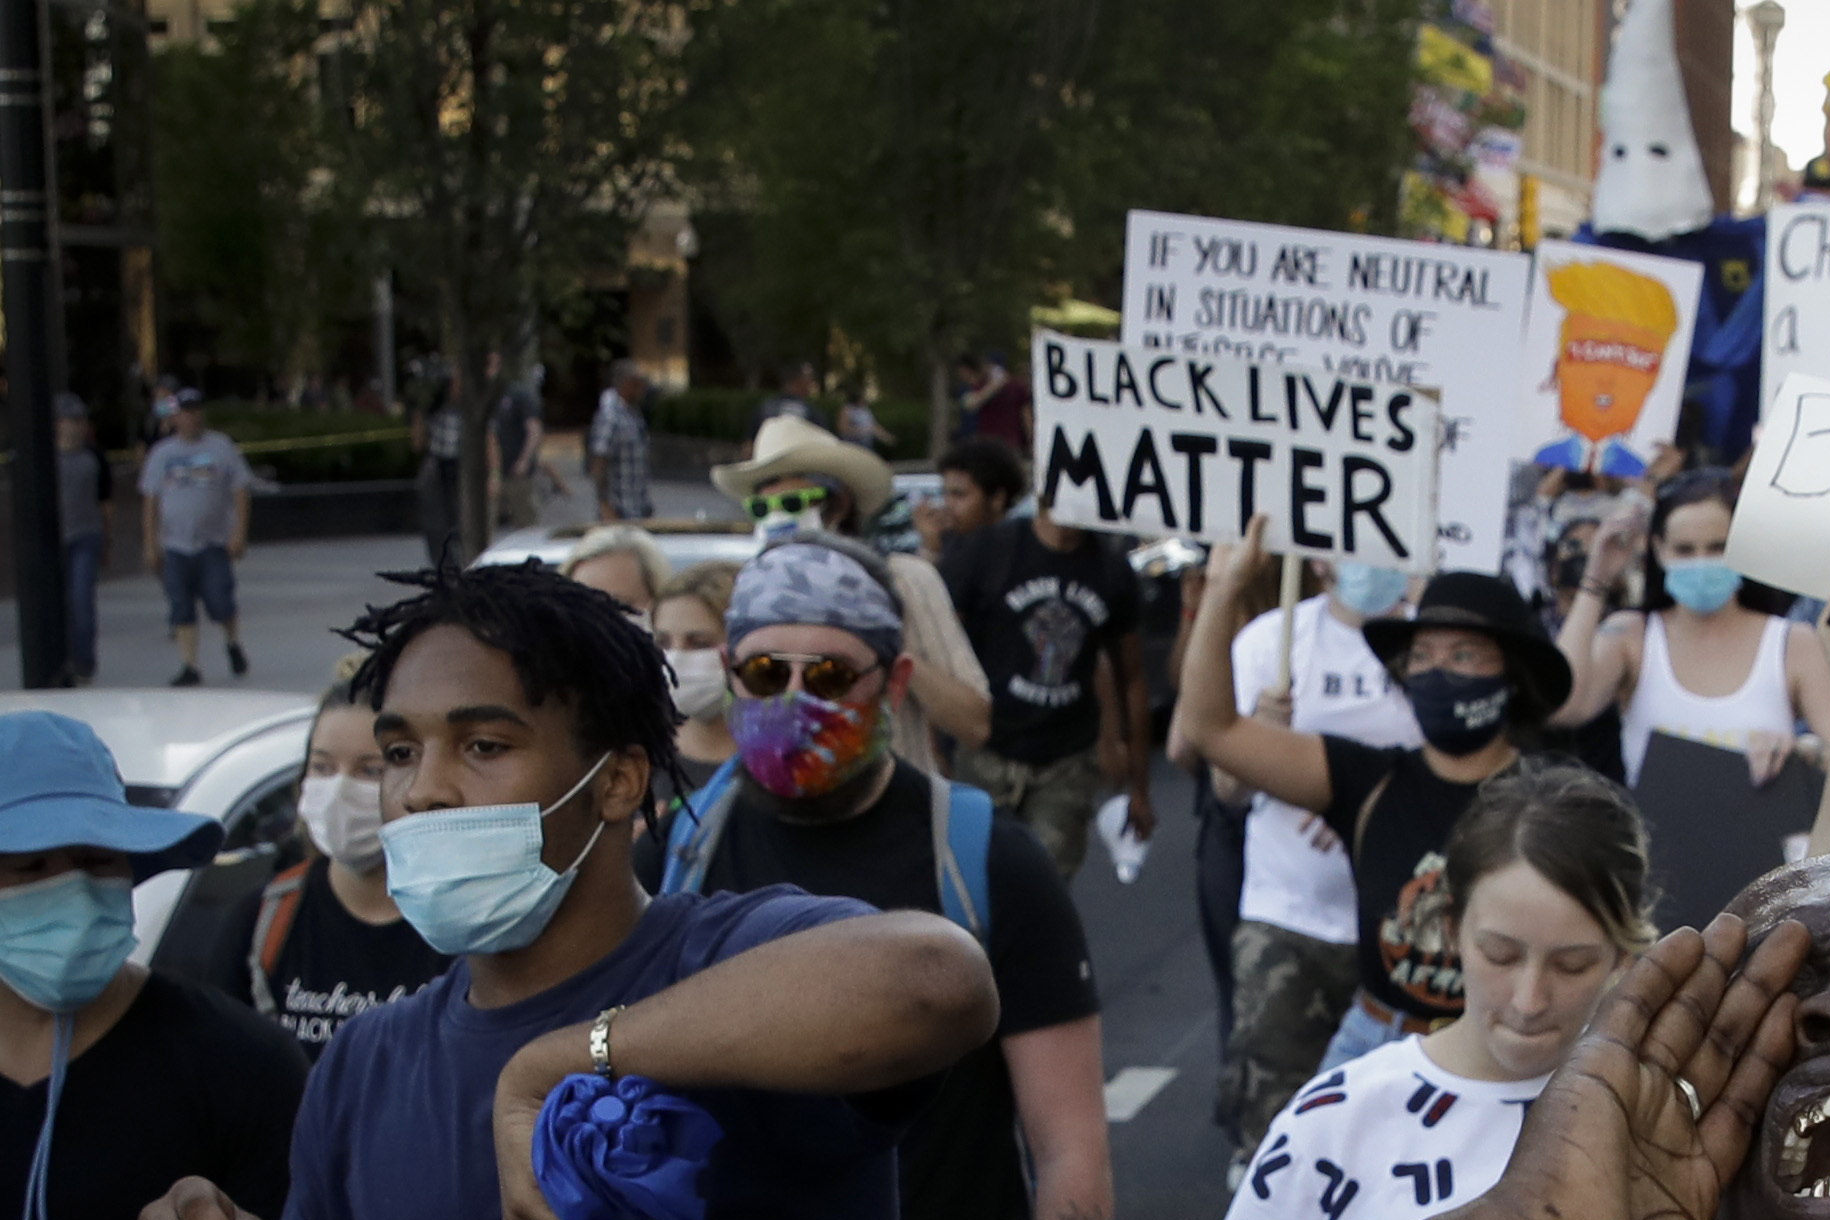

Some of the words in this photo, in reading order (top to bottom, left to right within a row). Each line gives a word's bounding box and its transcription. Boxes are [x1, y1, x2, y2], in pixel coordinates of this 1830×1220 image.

[1144, 283, 1175, 322] IN
[1197, 287, 1372, 350] SITUATIONS
[1391, 310, 1438, 353] OF
[1148, 232, 1180, 269] IF
[1194, 236, 1257, 281] YOU
[1272, 244, 1332, 288] ARE
[1348, 254, 1502, 310] NEUTRAL
[1045, 342, 1230, 420] BLACK
[1249, 364, 1416, 452] LIVES
[1044, 425, 1410, 559] MATTER
